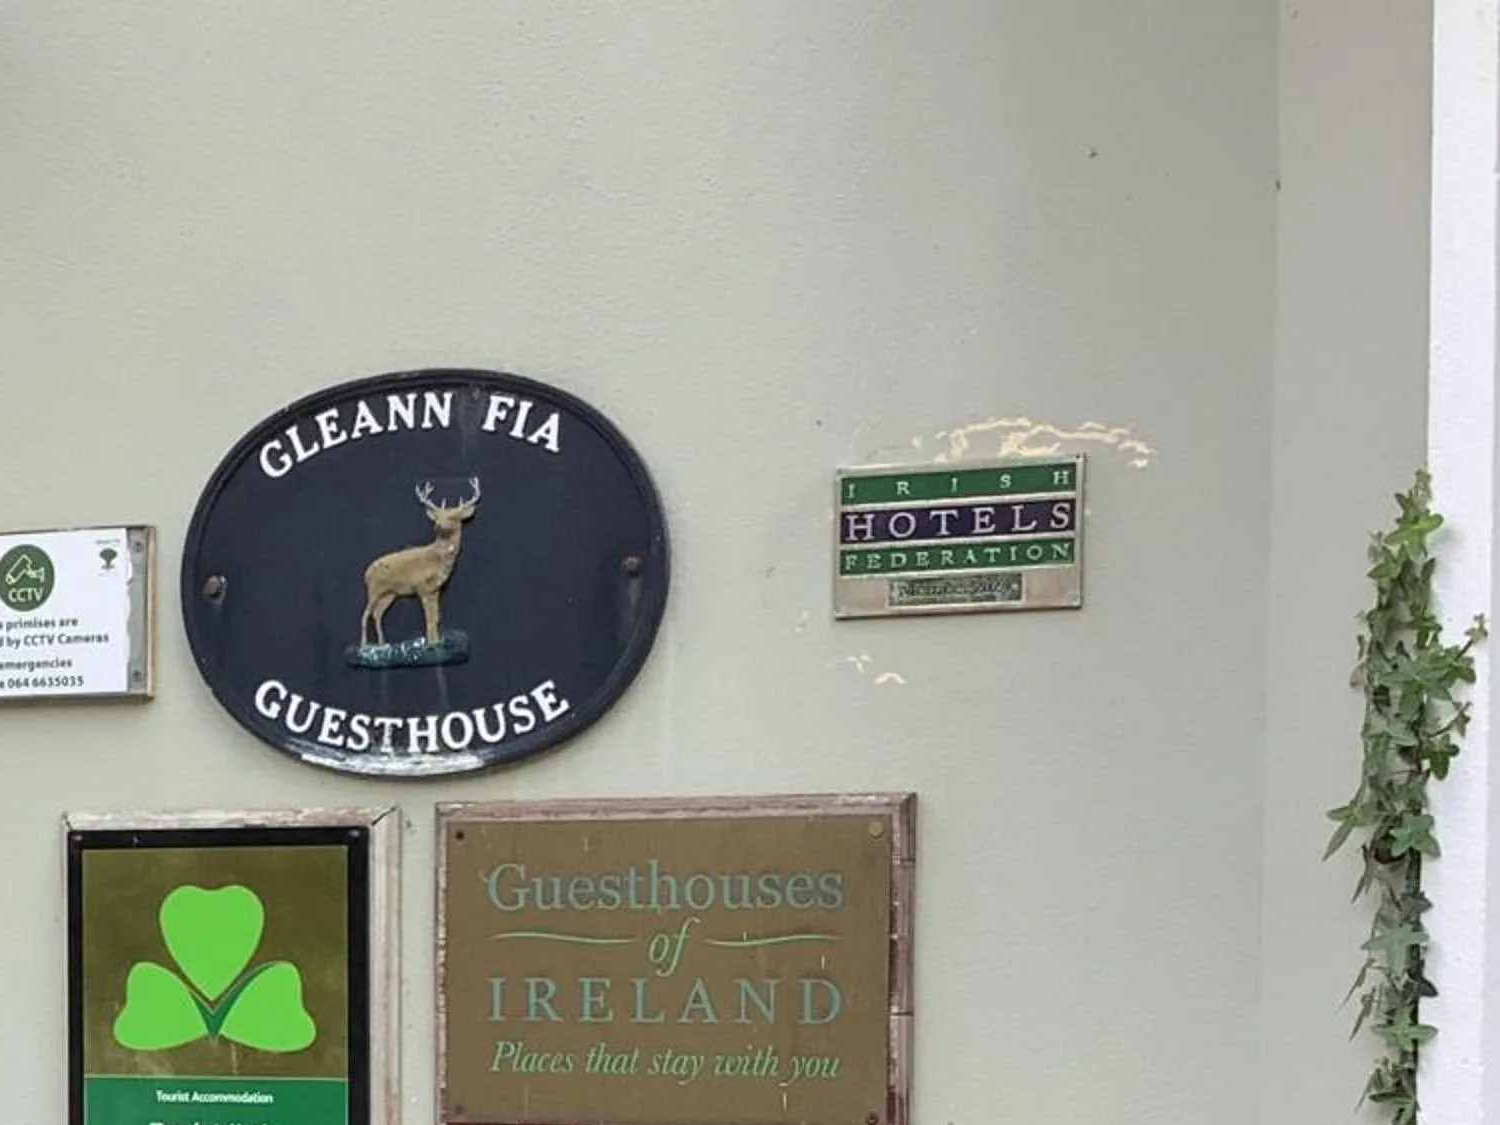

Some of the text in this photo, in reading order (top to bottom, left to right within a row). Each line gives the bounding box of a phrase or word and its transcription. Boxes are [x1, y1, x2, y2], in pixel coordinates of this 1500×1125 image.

[259, 392, 562, 478] GLEANN FIA
[847, 470, 1070, 498] IRISH
[845, 502, 1071, 541] HOTELS
[844, 543, 1070, 570] FEDERATION
[8, 587, 44, 603] CCTV
[58, 617, 78, 627] are
[7, 635, 21, 649] by
[23, 634, 55, 647] CCTV
[57, 632, 110, 645] Cameras
[7, 677, 29, 688] 064
[32, 675, 85, 688] 6635035
[254, 679, 570, 753] GUESTHOUSE
[486, 859, 844, 911] Guesthouses
[648, 916, 701, 977] of
[486, 976, 842, 1025] IRELAND
[488, 1041, 839, 1087] Places that stay with you
[156, 1090, 274, 1104] Tourist Accommodation
